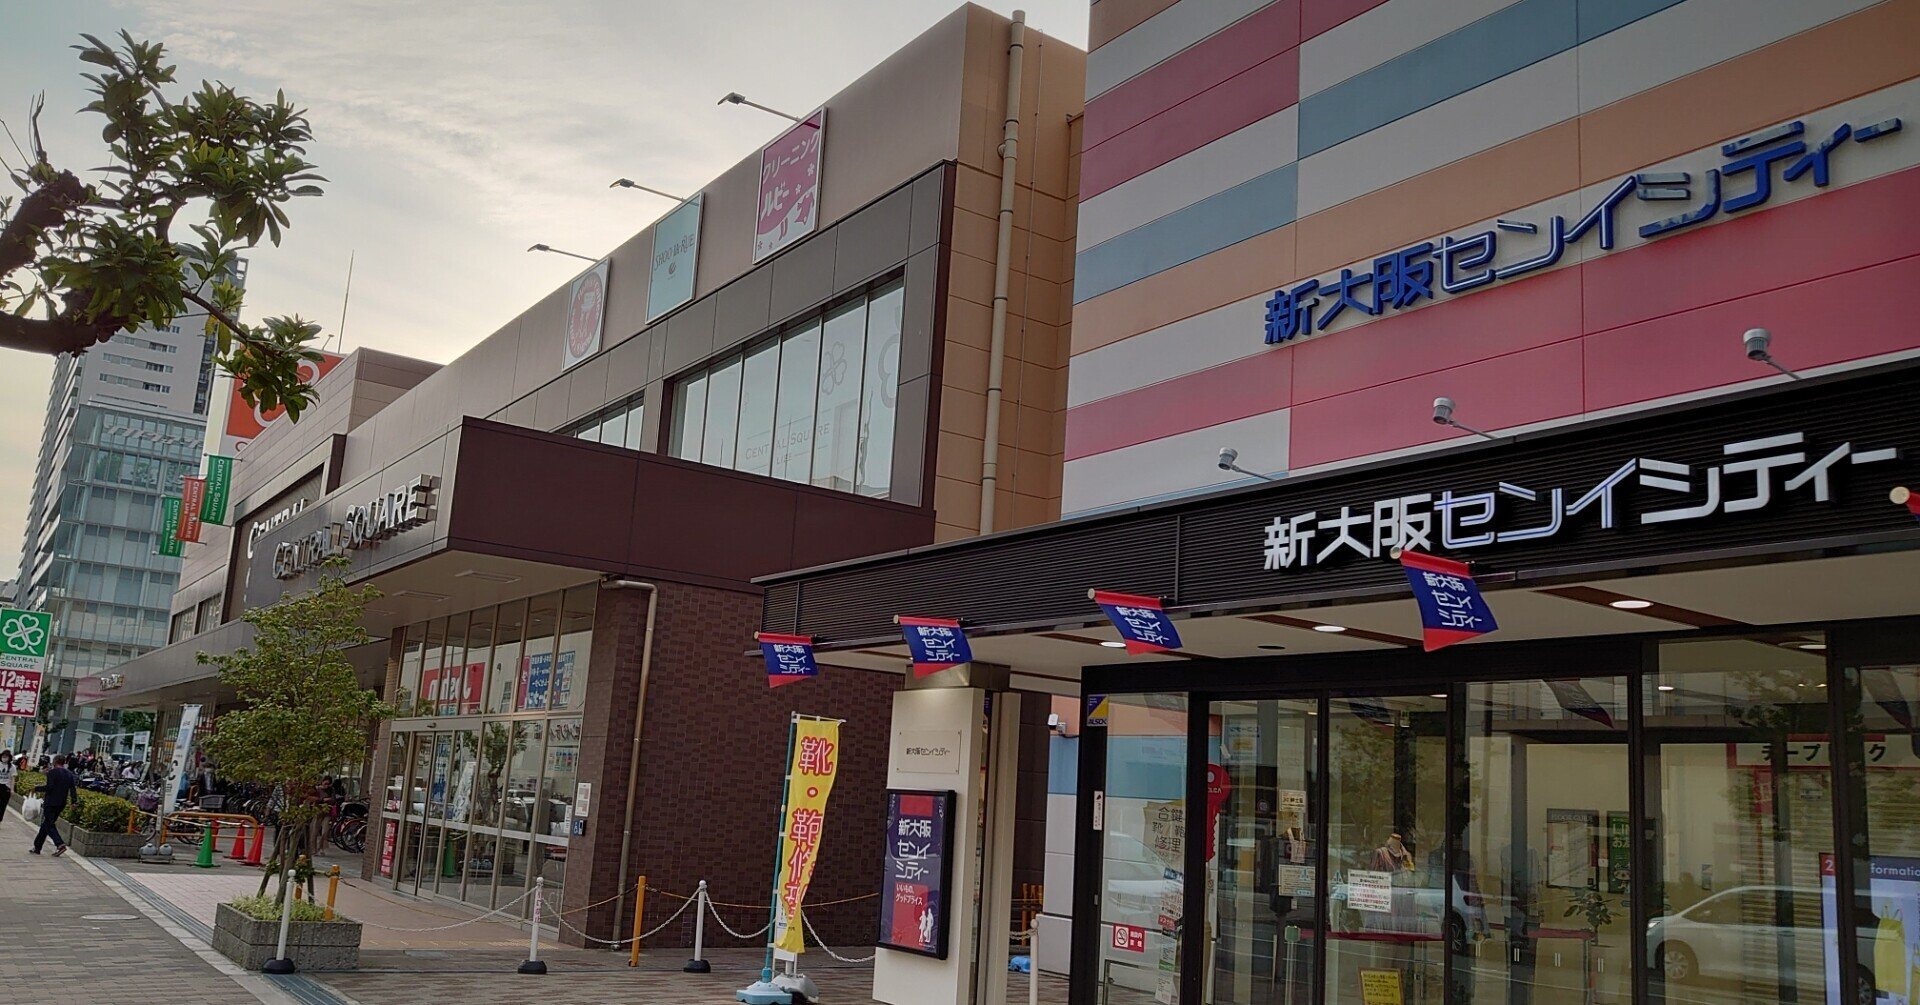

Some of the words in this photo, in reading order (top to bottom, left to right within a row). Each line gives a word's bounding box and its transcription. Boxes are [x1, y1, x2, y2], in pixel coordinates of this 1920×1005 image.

[763, 131, 820, 184] クリーニング
[760, 180, 790, 221] ルビー
[1264, 117, 1902, 345] 新大阪センイシティー
[745, 437, 788, 460] CENTAL
[790, 422, 831, 446] SQURE
[216, 459, 225, 490] CENTRAL
[190, 481, 199, 510] CENTRAL
[1264, 432, 1898, 570] 新大阪センイシティー
[171, 500, 180, 529] CENTRAL
[210, 493, 220, 521] SQUARE
[186, 512, 196, 539] SQUARE
[272, 522, 344, 579] CENTRAL
[342, 474, 434, 549] SQUARE
[1423, 571, 1467, 592] 新大阪
[1431, 589, 1472, 610] センイ
[1124, 616, 1161, 632] センイ
[1438, 608, 1483, 628] シティー
[922, 638, 956, 648] センイ
[1131, 628, 1170, 645] シティー
[1, 660, 36, 670] SQUARE
[777, 653, 807, 663] センイ
[925, 649, 961, 662] シティー
[779, 663, 811, 674] シティー
[897, 820, 932, 838] 新大阪
[897, 840, 931, 859] センイ
[1154, 834, 1181, 852] 修理
[895, 861, 929, 883] シティー
[1871, 862, 1920, 877] formatio
